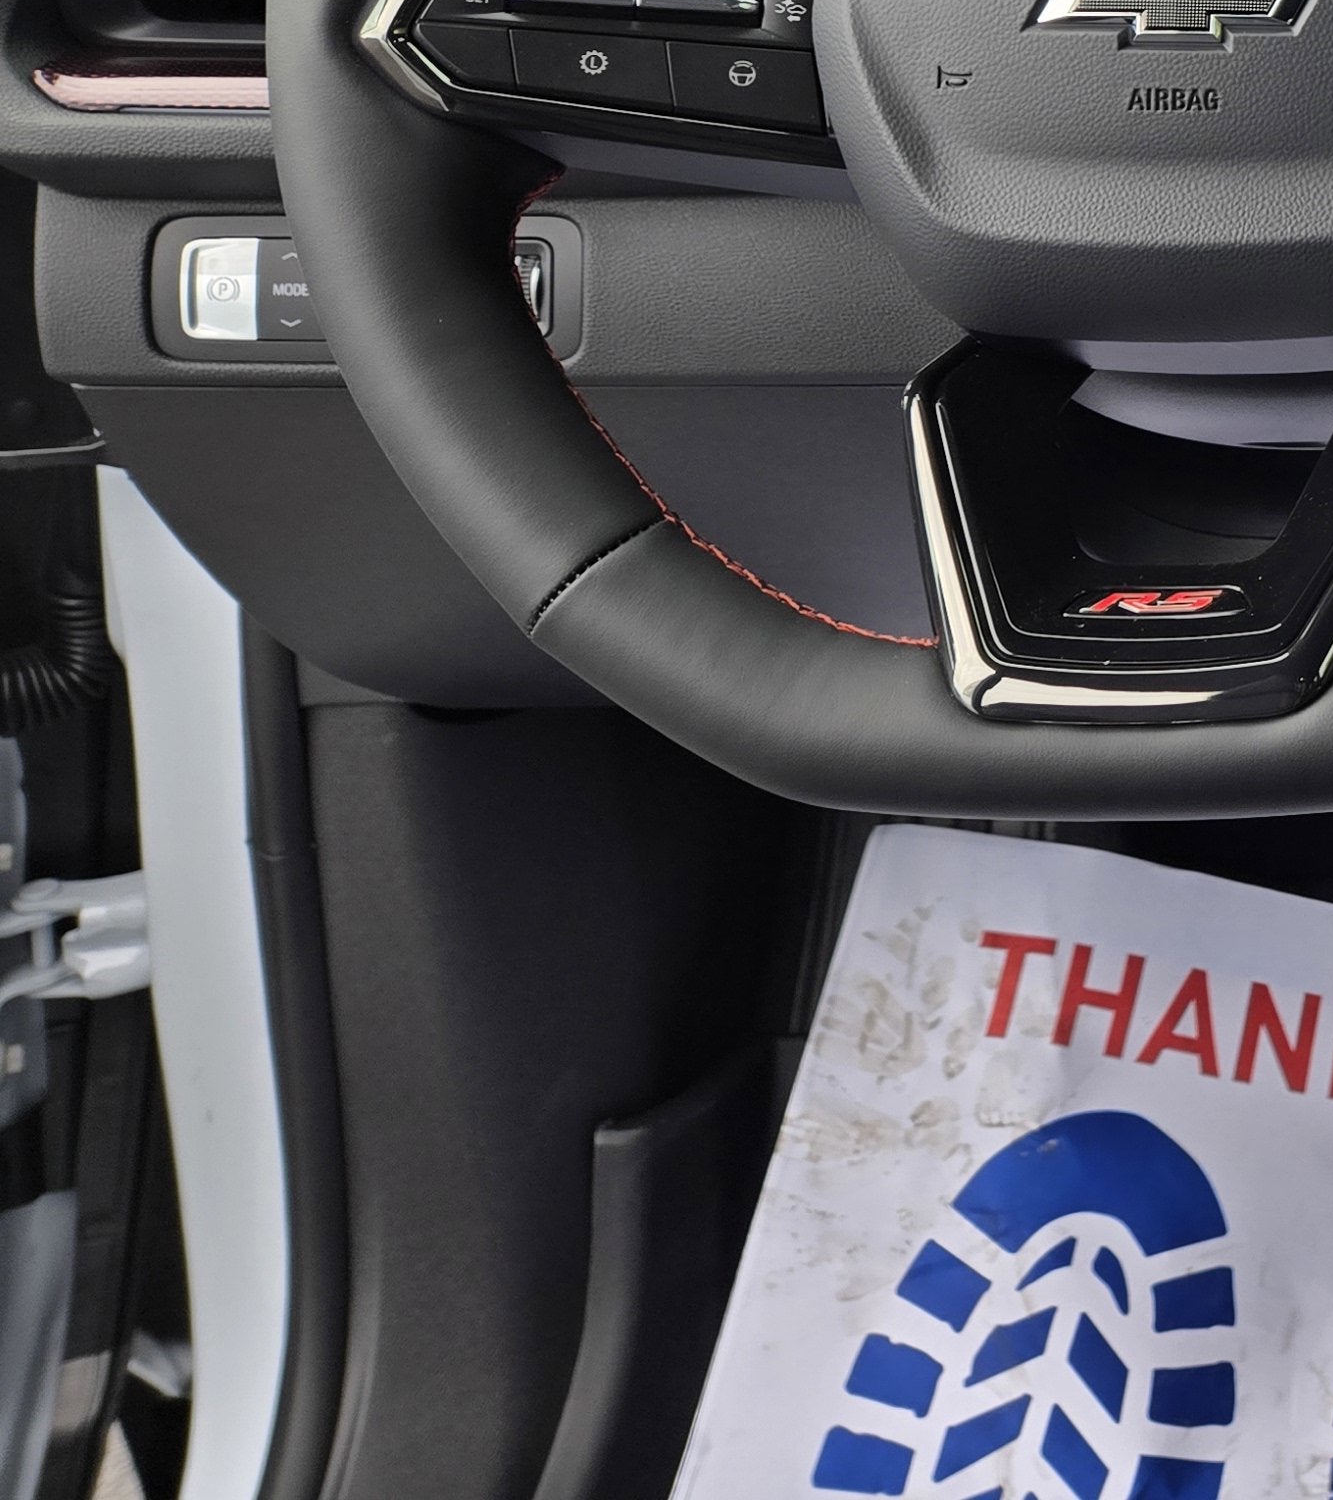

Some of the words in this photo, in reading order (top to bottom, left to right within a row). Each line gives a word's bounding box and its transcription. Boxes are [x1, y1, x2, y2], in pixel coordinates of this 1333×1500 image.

[1127, 88, 1220, 112] AIRBAG
[272, 282, 309, 297] MODE
[1085, 591, 1225, 613] RS
